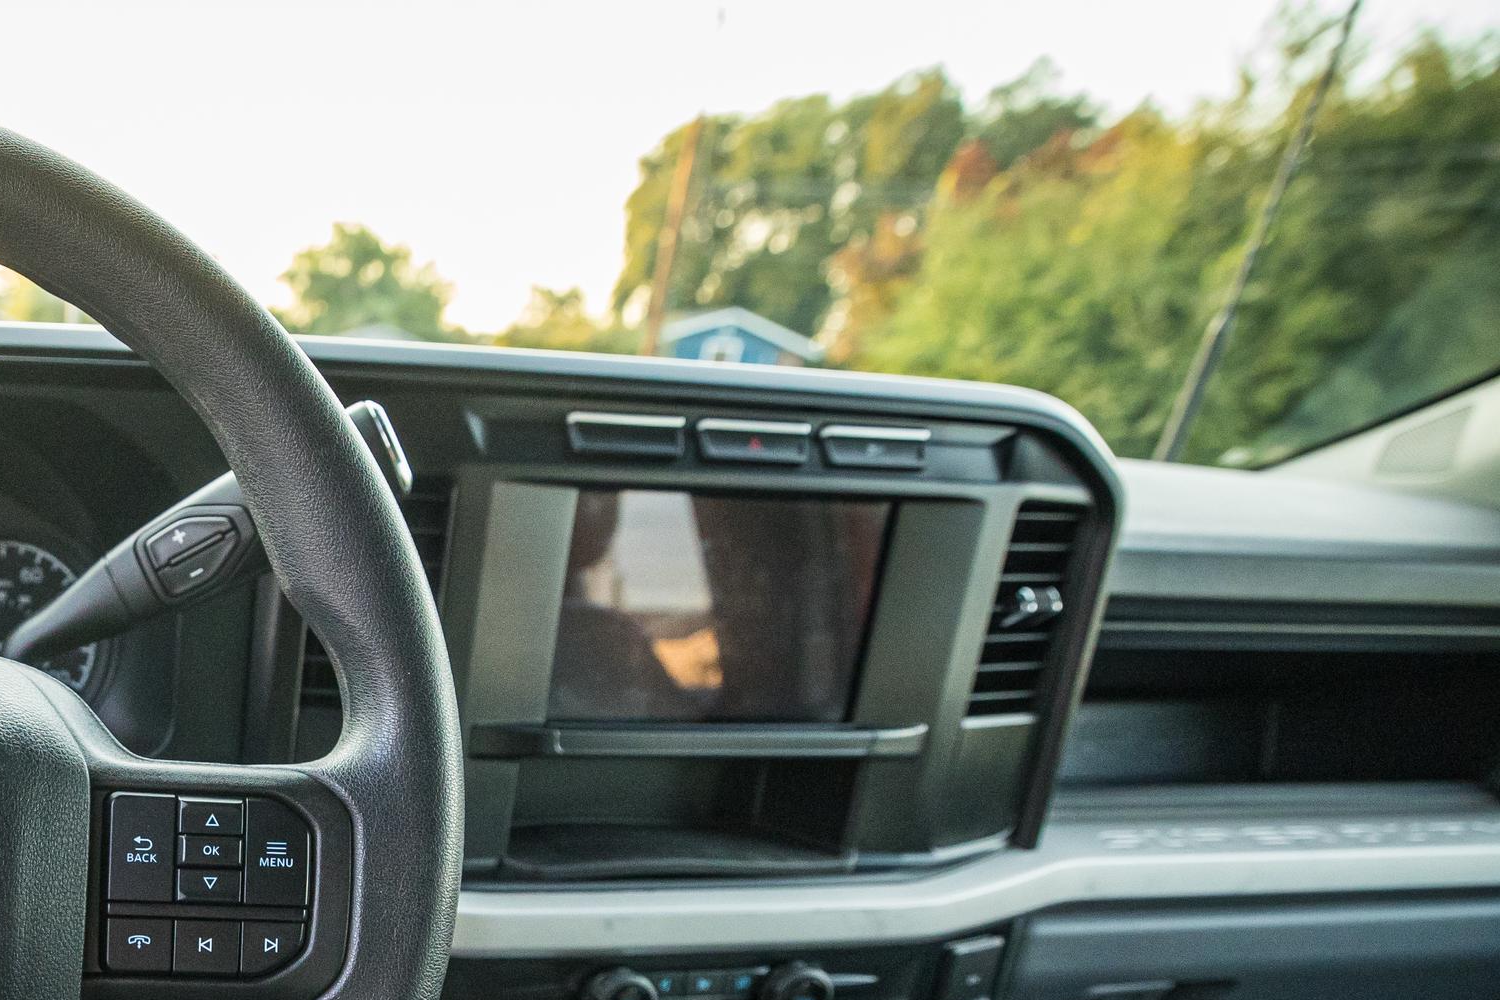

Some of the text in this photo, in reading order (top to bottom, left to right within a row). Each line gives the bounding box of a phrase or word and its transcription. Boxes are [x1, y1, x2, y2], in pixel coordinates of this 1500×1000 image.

[202, 845, 220, 856] OK
[126, 852, 157, 863] BACK
[259, 857, 294, 868] MENU
